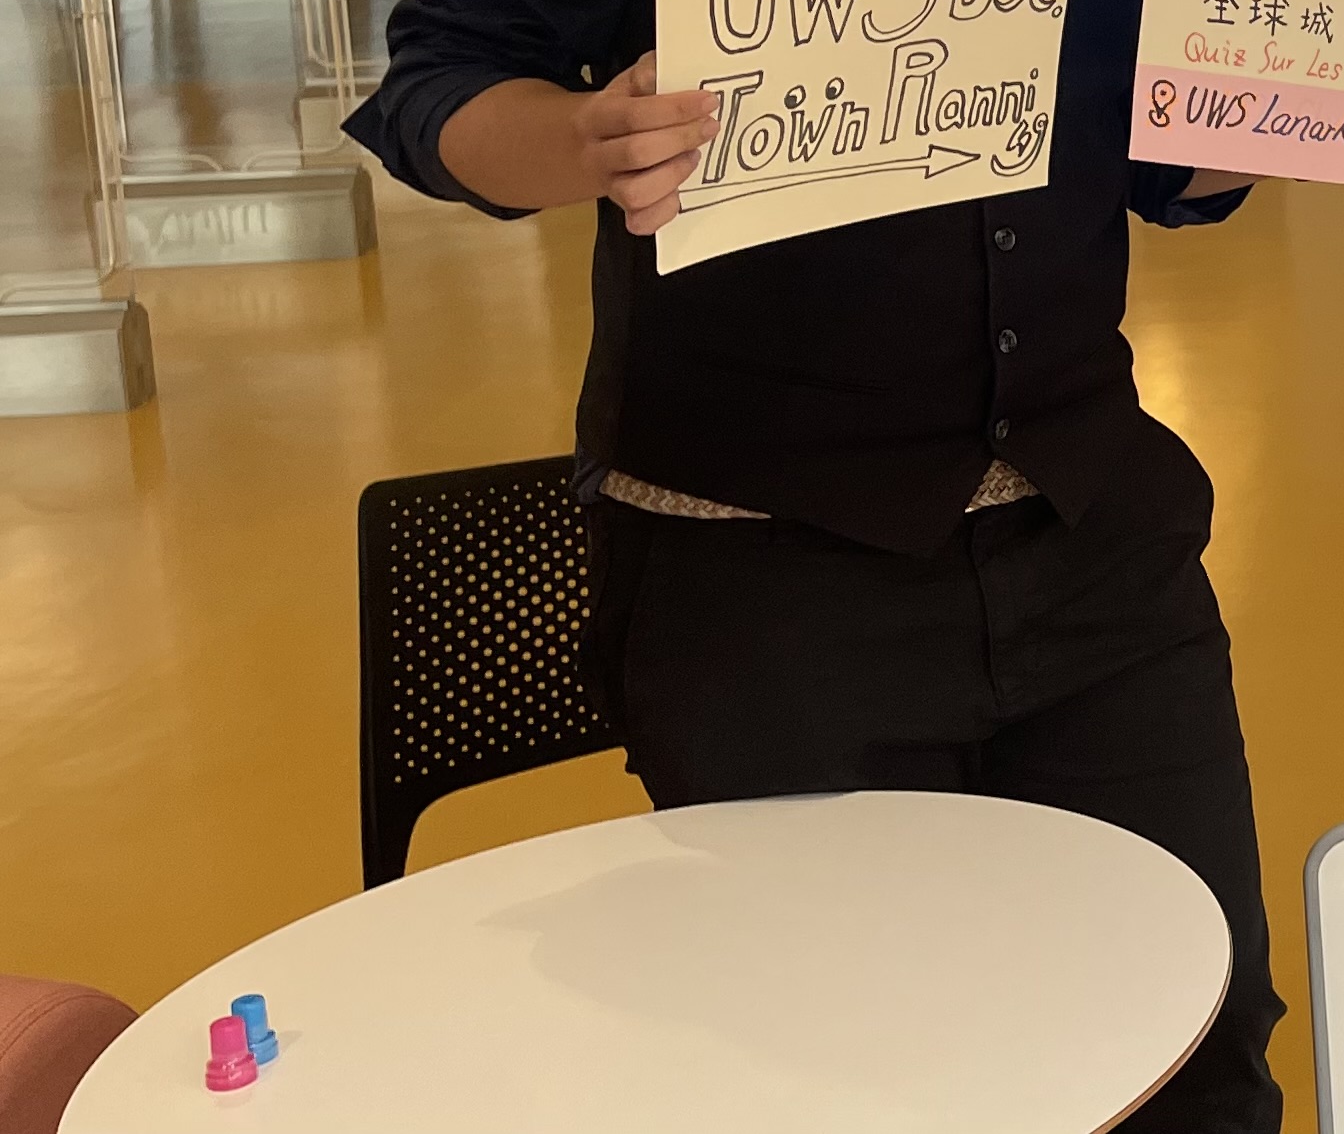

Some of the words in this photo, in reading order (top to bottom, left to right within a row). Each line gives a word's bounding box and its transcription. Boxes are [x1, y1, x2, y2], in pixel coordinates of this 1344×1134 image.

[1184, 32, 1248, 68] Quiz
[1258, 40, 1295, 74] Sur
[1306, 48, 1344, 80] Les
[700, 70, 869, 184] Town
[1186, 86, 1257, 130] UWS
